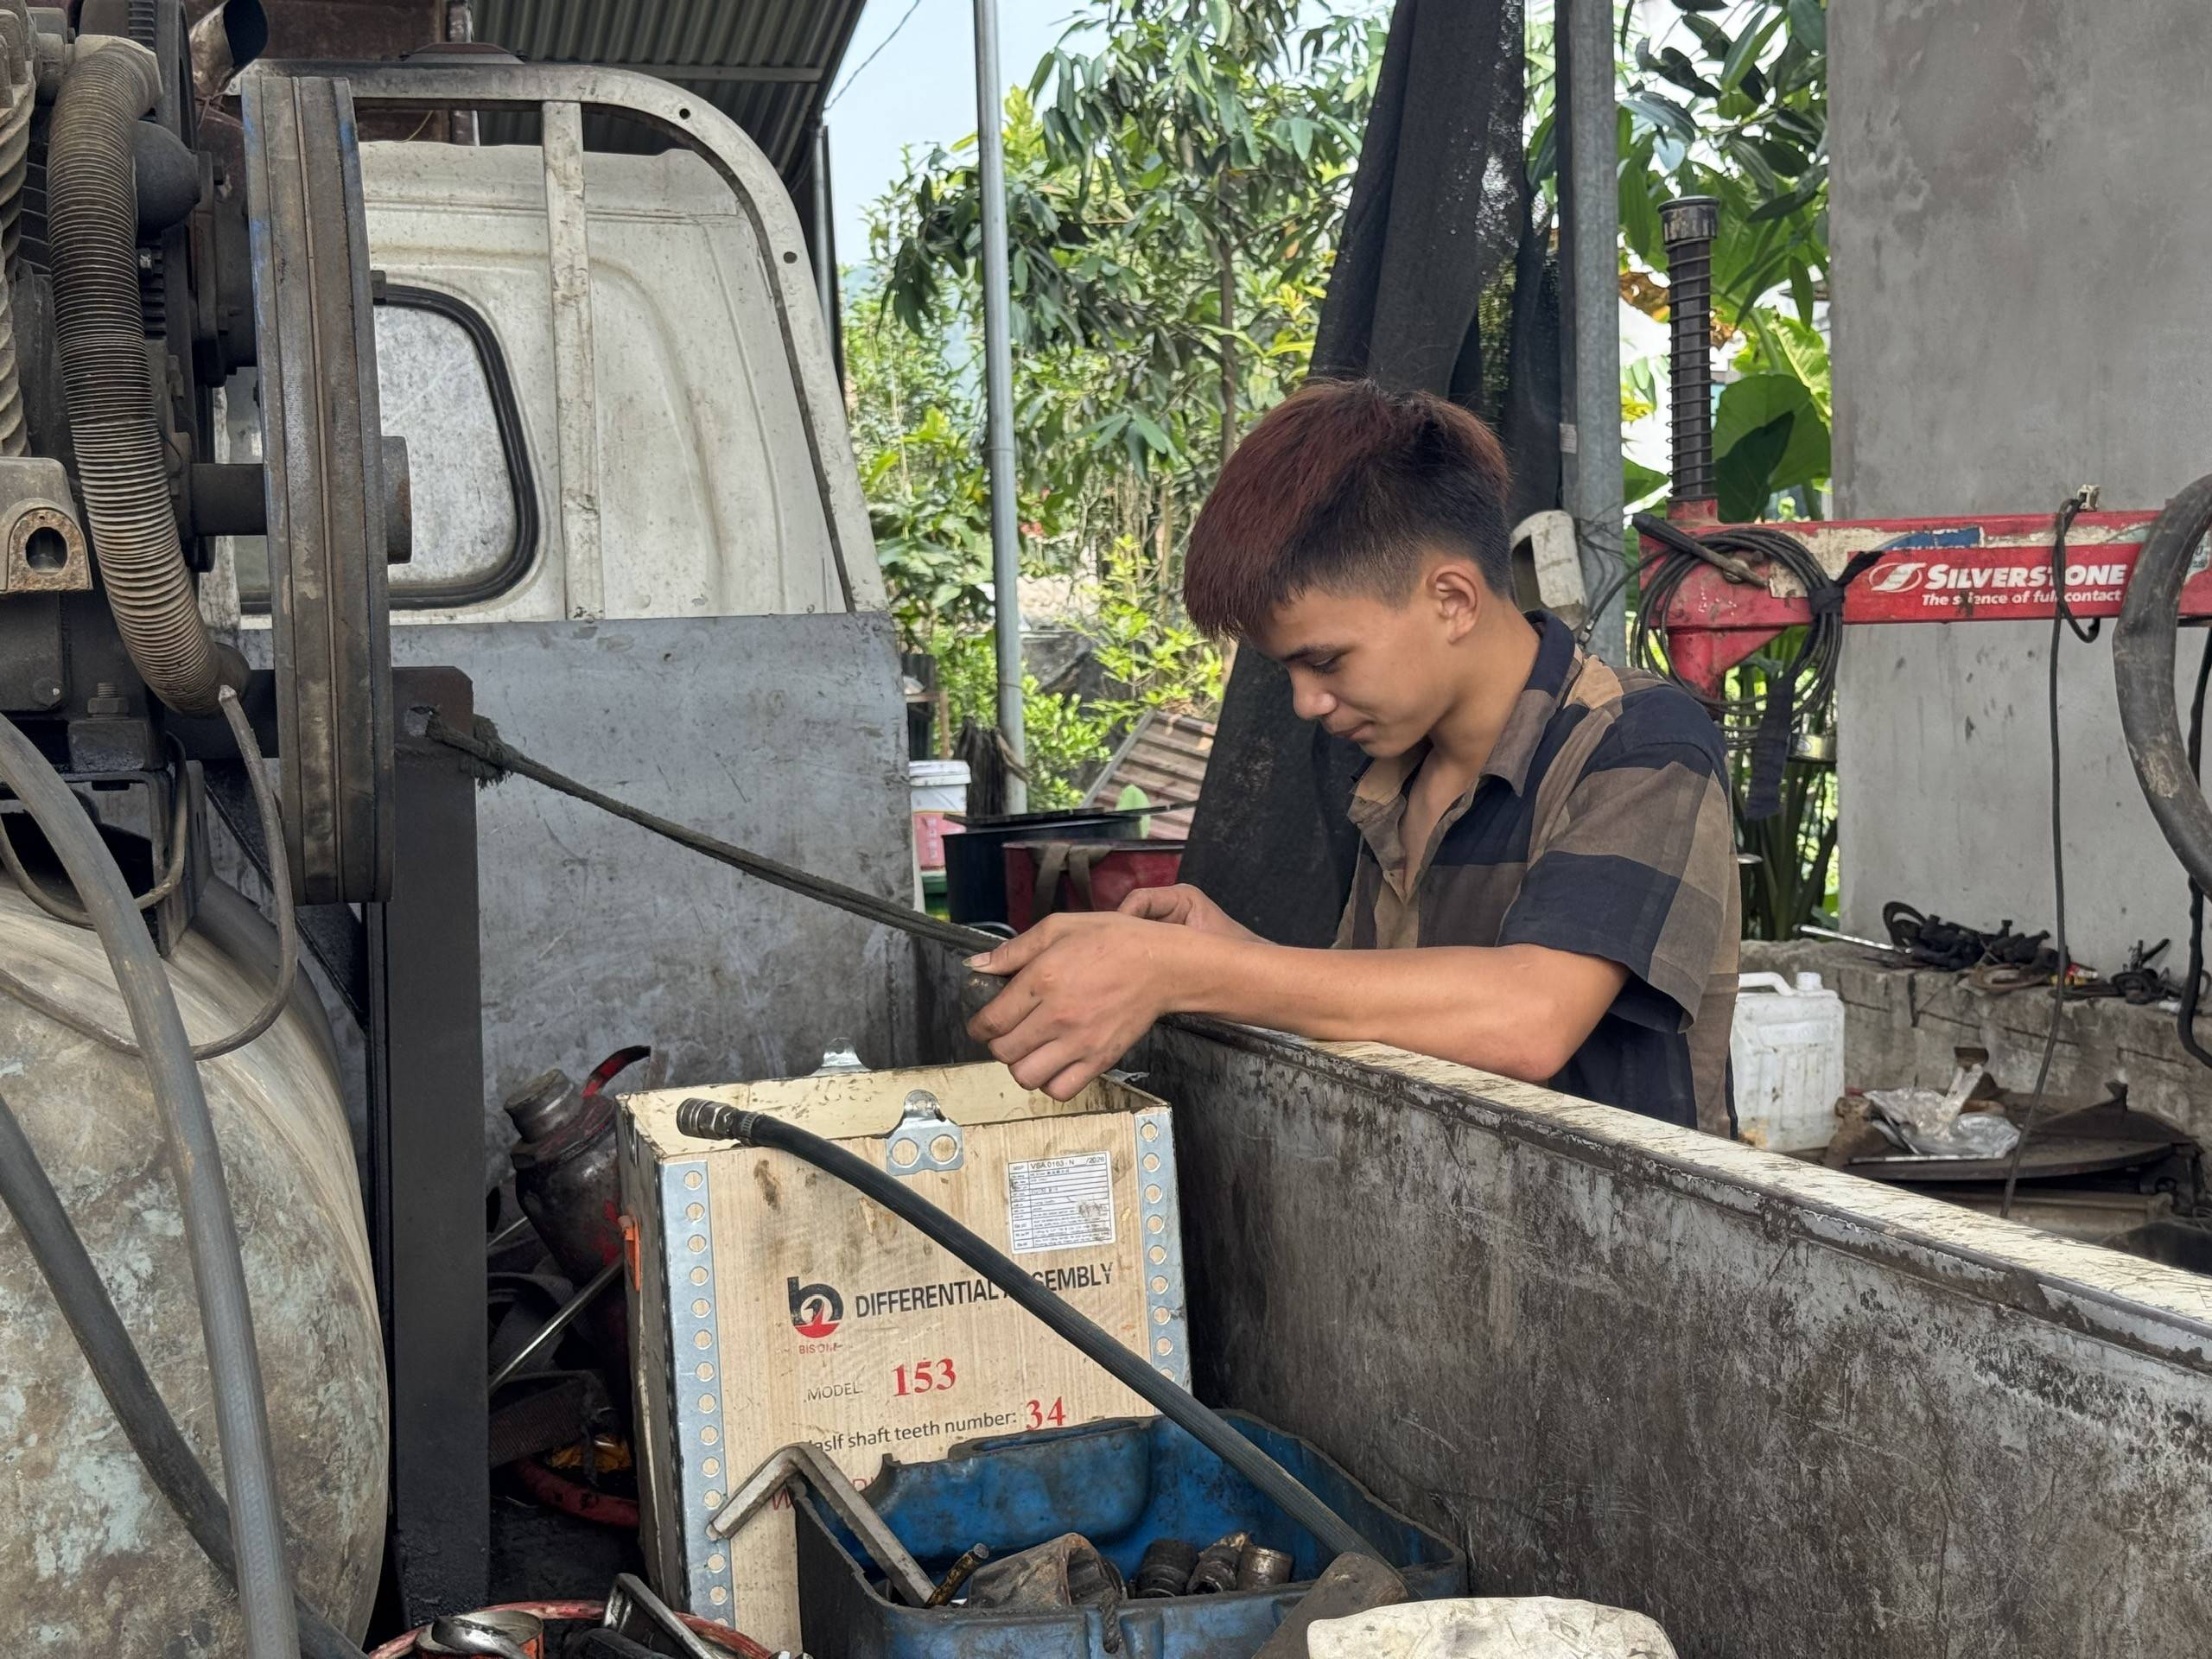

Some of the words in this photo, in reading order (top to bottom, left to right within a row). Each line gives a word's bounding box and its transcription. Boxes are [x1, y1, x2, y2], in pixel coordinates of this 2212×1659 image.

[1922, 593, 1949, 606] The
[1952, 591, 2008, 605] sience
[2012, 590, 2031, 604] of
[2063, 589, 2123, 602] contact
[856, 1278, 1000, 1318] DIFFERENTIAL
[1003, 1262, 1114, 1299] SEMBLY
[893, 1357, 957, 1397] 153
[848, 1427, 891, 1448] shaft
[895, 1421, 940, 1441] teeth
[944, 1410, 1017, 1434] number:
[1026, 1395, 1066, 1431] 34
